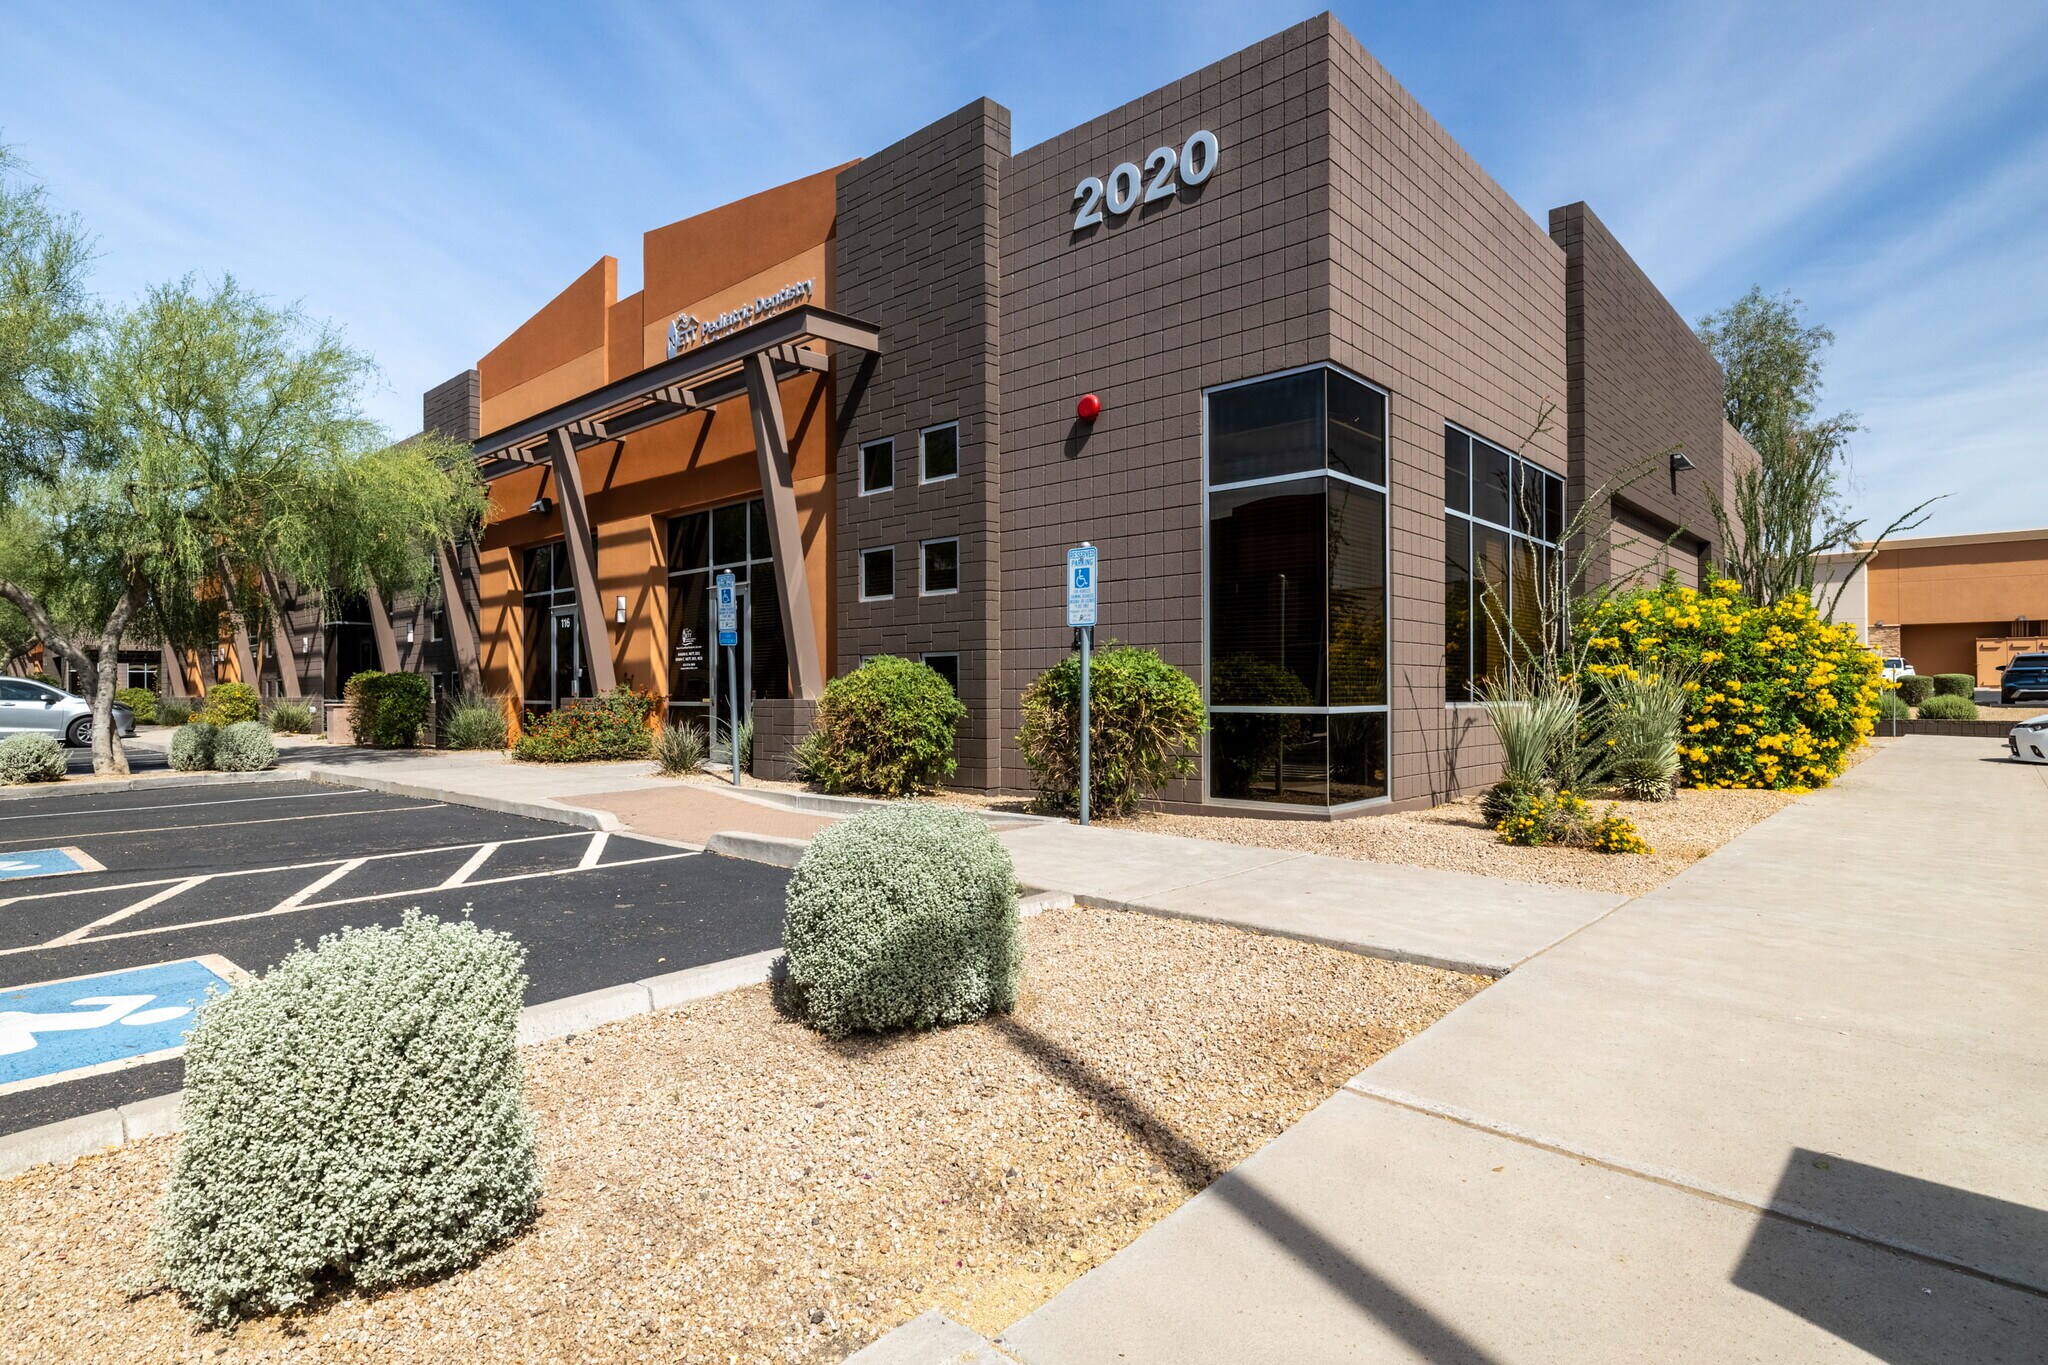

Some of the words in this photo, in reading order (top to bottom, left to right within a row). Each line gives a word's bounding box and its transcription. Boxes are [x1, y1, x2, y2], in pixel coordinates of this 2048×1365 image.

[1073, 129, 1219, 231] 2020
[702, 303, 753, 336] Pediatric
[754, 278, 815, 314] Dentistry
[668, 325, 697, 351] NETT
[1070, 550, 1095, 558] RESERVED
[1071, 557, 1094, 566] PARKING
